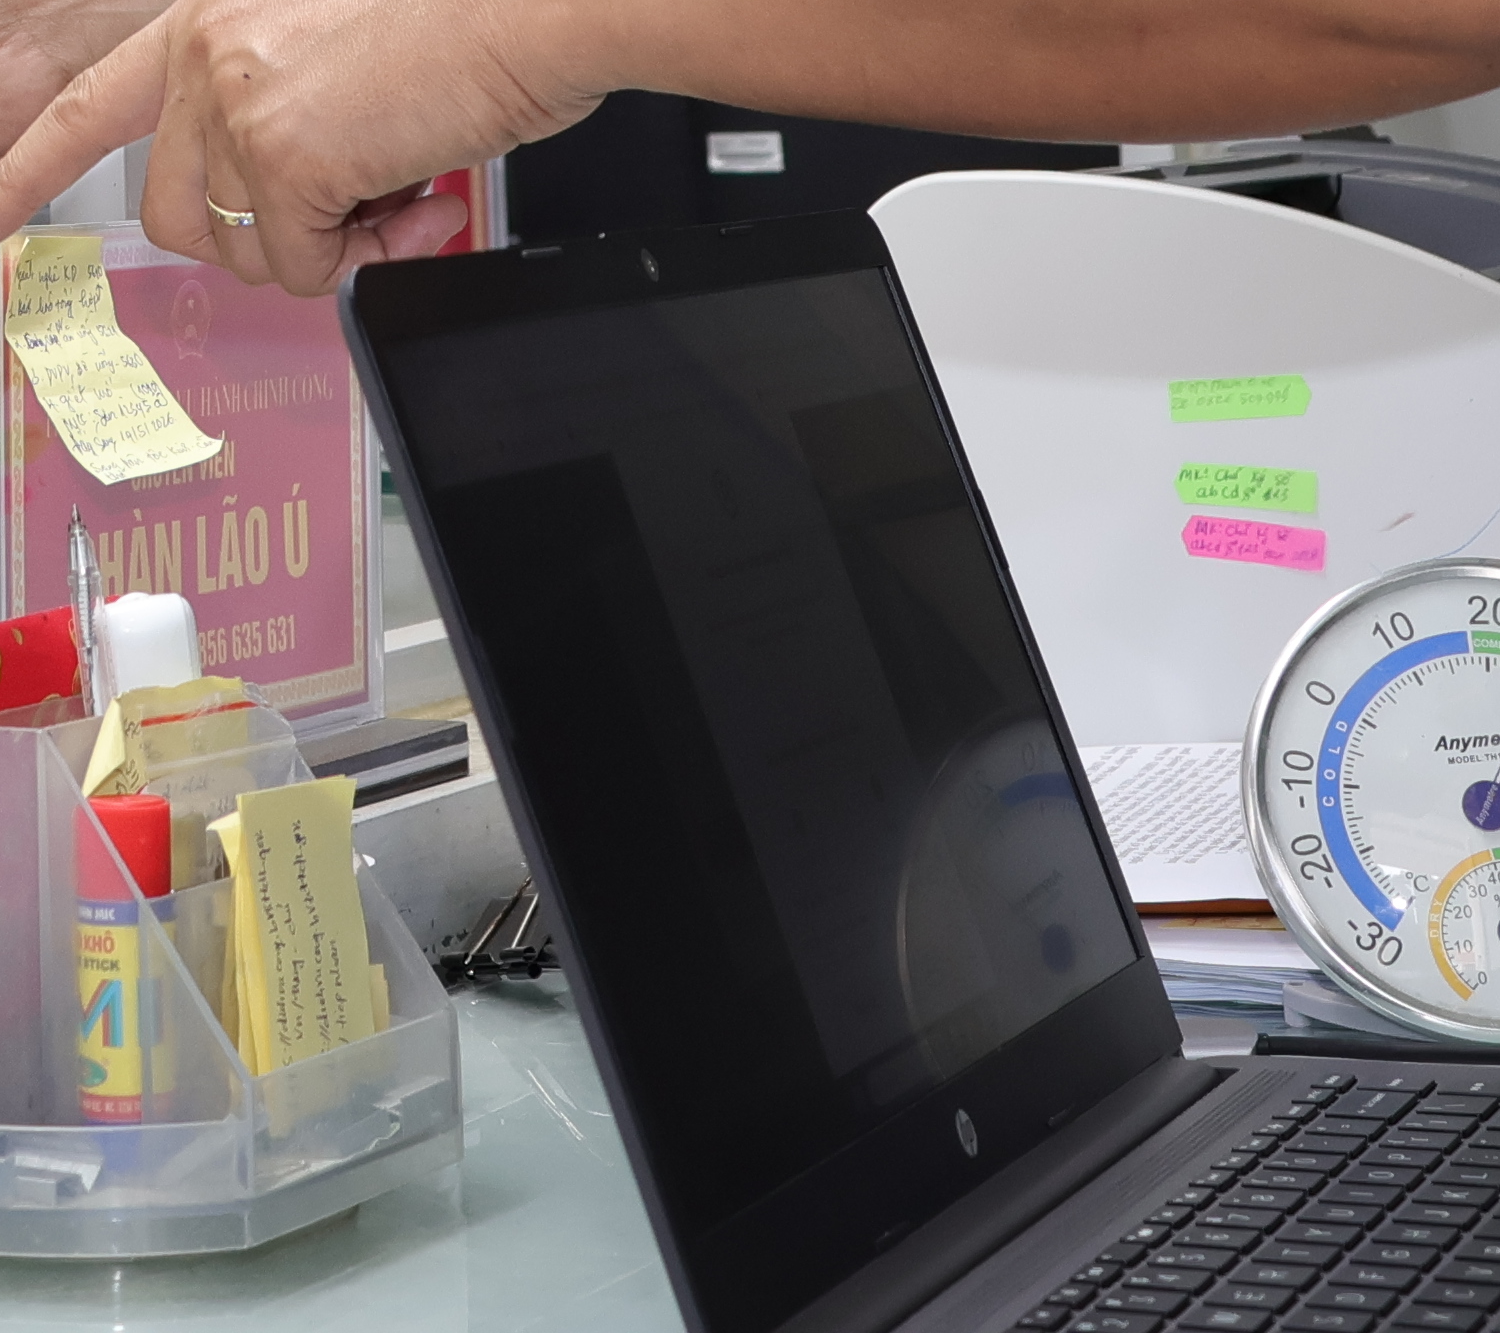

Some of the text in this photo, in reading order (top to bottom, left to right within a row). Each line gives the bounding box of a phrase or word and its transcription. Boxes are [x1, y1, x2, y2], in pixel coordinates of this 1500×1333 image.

[98, 483, 310, 595] HÀN LÃO Ú
[232, 619, 263, 662] 635
[267, 614, 297, 655] 631
[1371, 612, 1415, 649] 10
[1305, 680, 1336, 706] 0
[1281, 749, 1315, 809] -10
[1291, 833, 1334, 889] -20
[1467, 884, 1488, 899] 30
[1429, 898, 1444, 938] DRY
[1453, 904, 1473, 920] 20
[1347, 919, 1403, 967] -30
[1454, 939, 1473, 954] 10
[1477, 970, 1488, 985] 0
